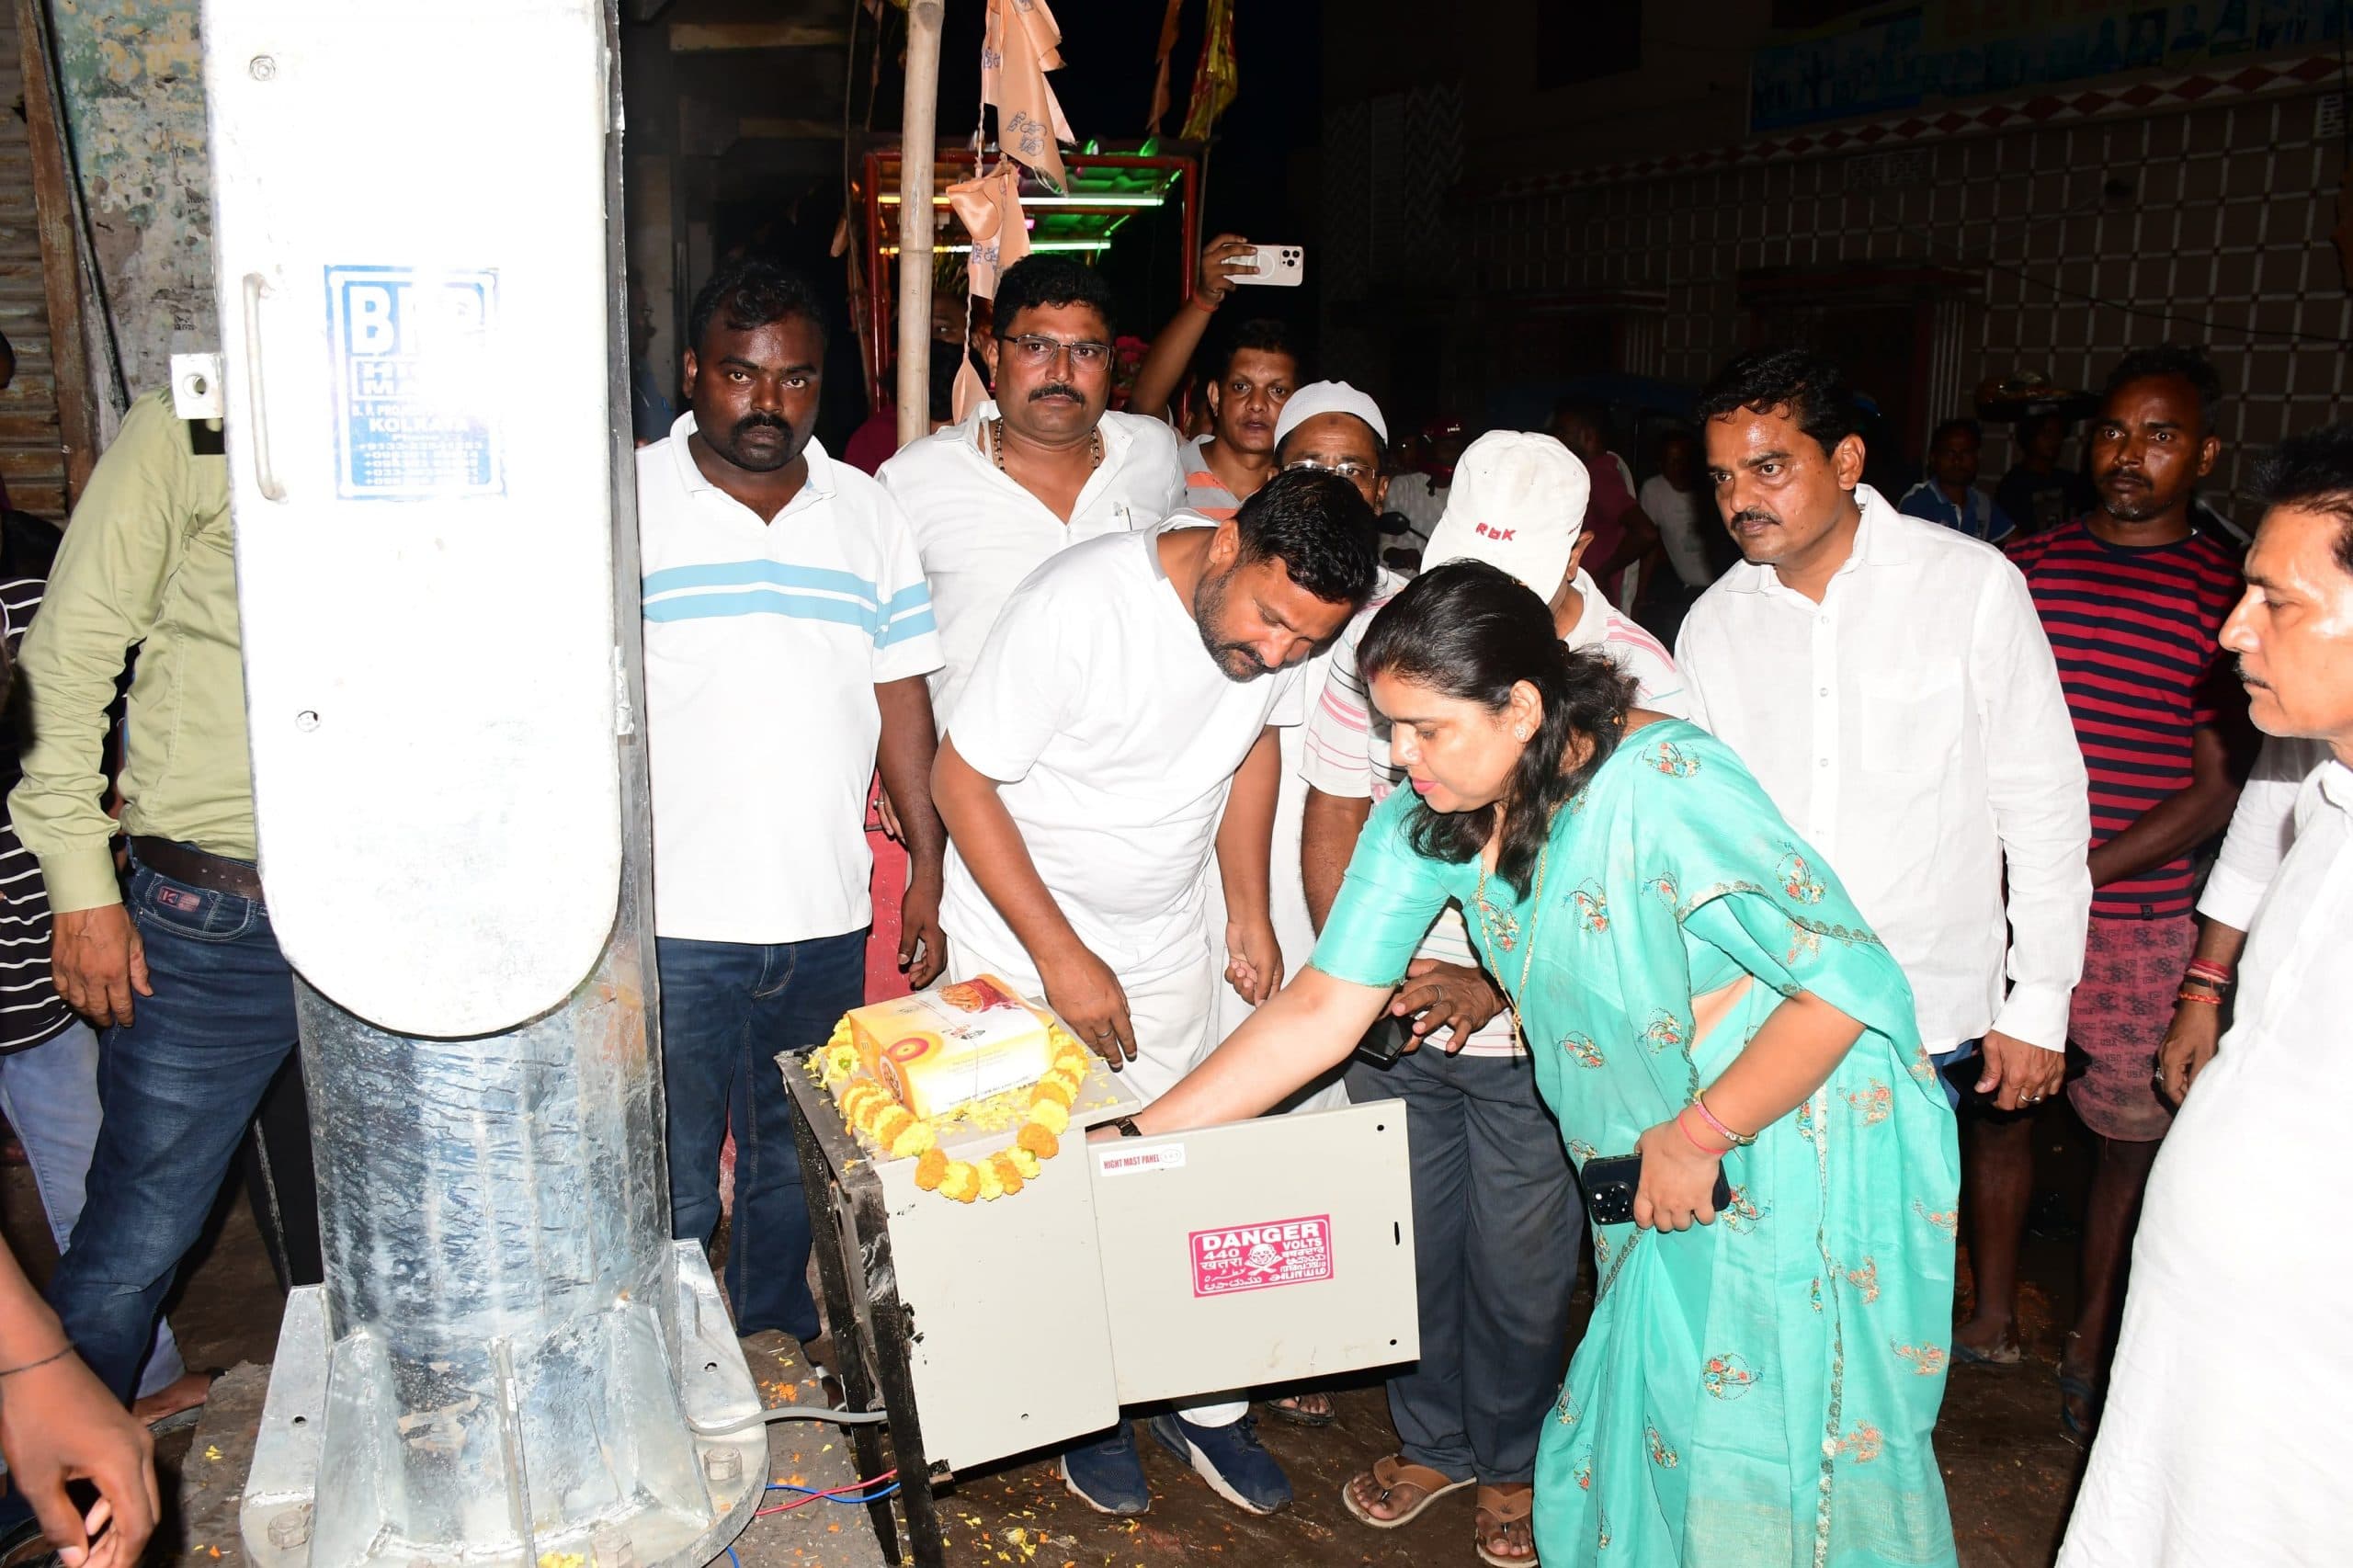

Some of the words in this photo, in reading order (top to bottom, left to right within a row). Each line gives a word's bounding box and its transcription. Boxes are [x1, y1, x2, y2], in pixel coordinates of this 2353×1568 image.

[1123, 1156, 1141, 1166] MAST
[1201, 1222, 1320, 1251] DANGER
[1203, 1248, 1240, 1261] 440
[1282, 1237, 1323, 1250] VOLTS
[1199, 1256, 1243, 1270] खतरा
